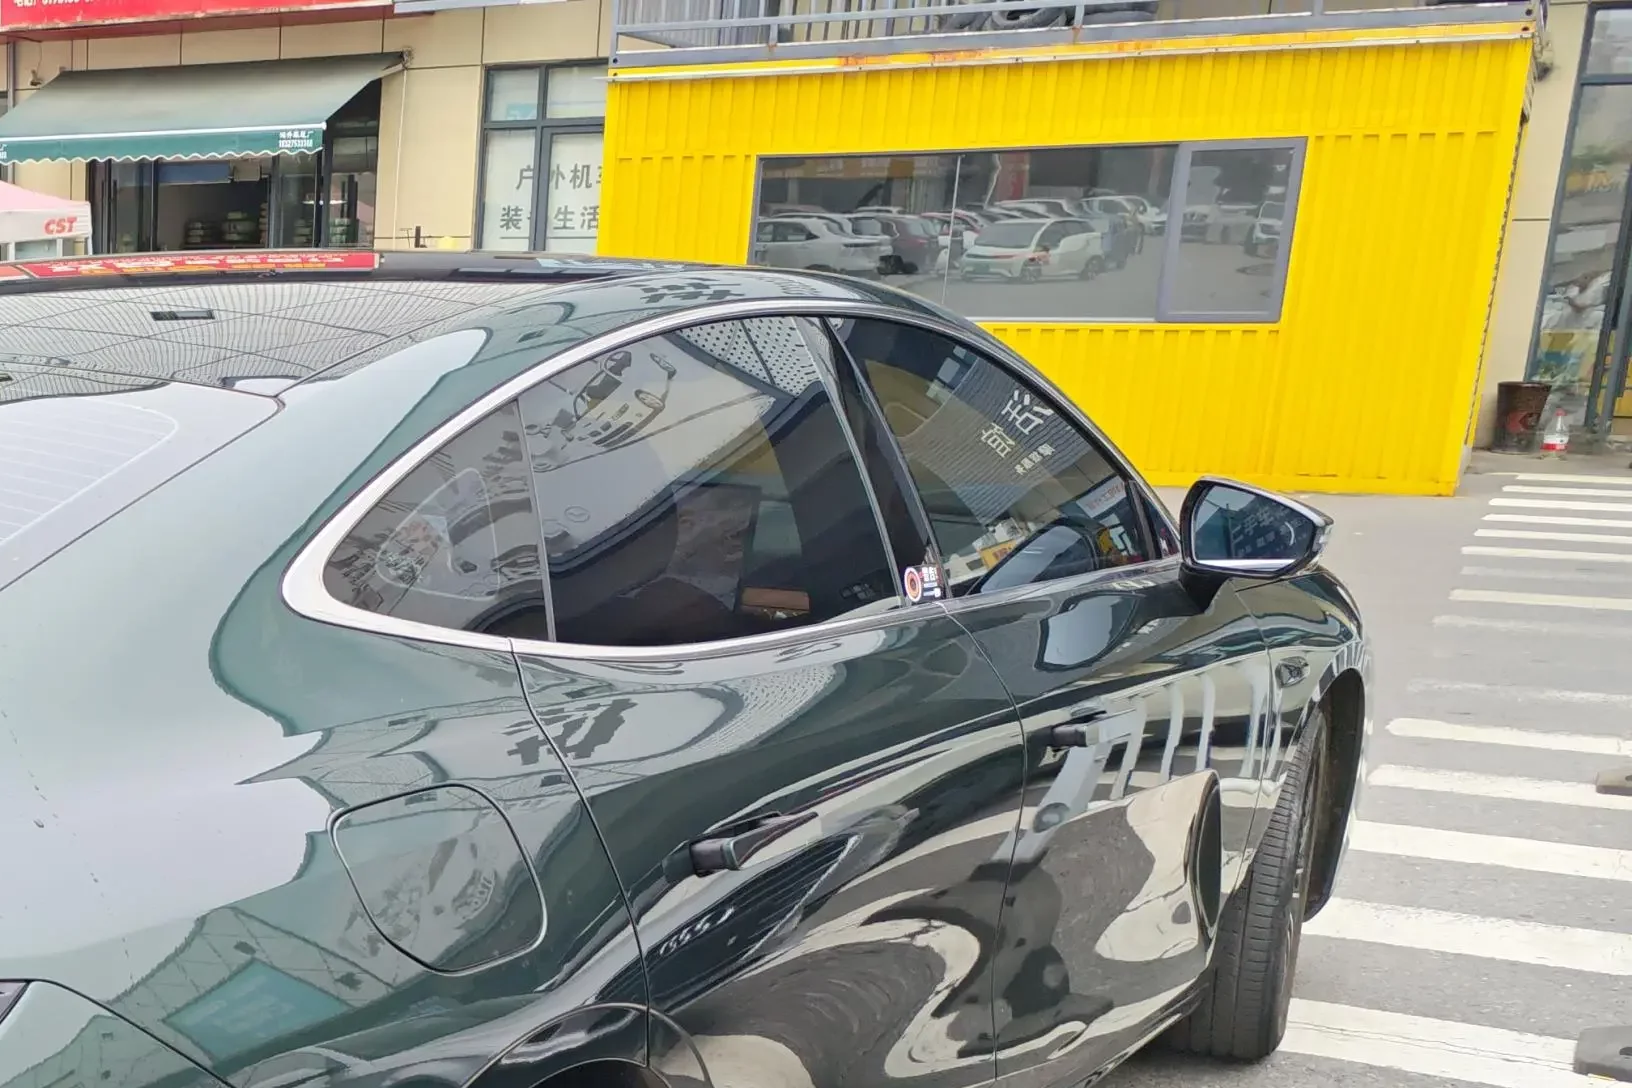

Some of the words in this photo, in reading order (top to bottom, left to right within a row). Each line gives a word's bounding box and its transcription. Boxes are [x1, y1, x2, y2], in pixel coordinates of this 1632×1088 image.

[44, 217, 78, 234] CST
[500, 205, 600, 231] 装生活
